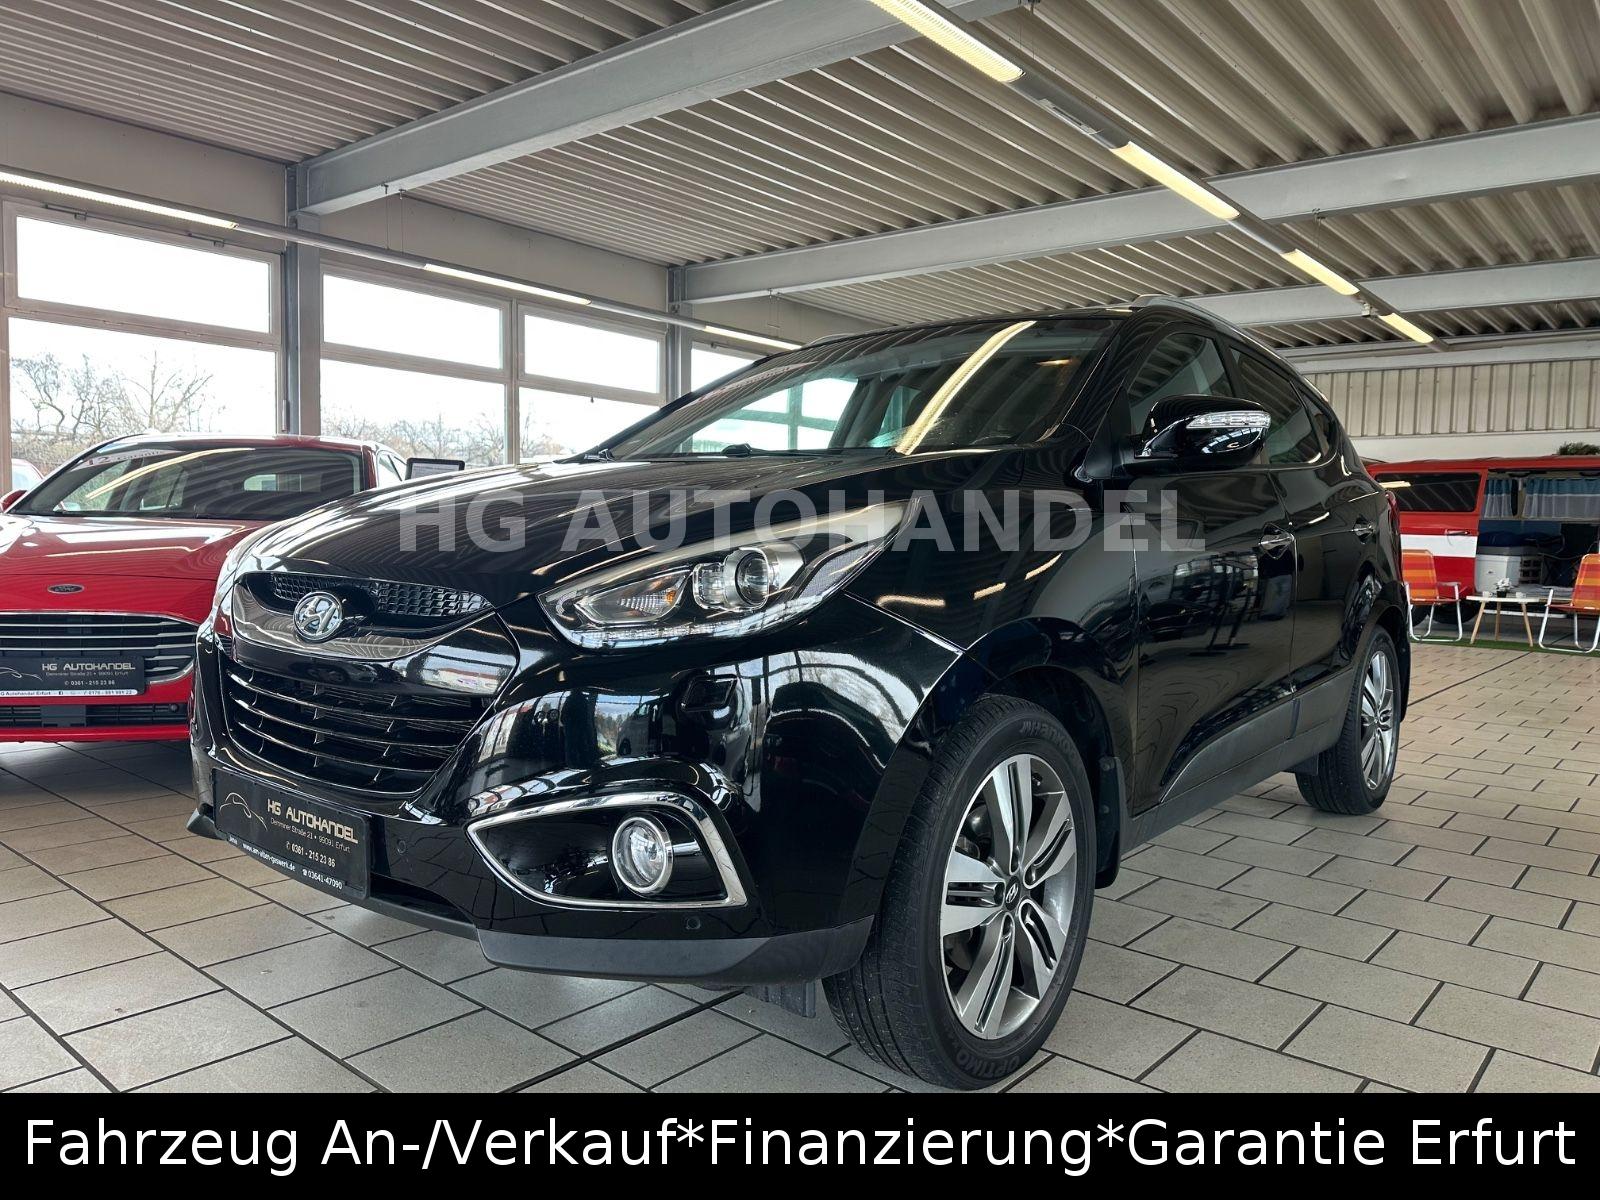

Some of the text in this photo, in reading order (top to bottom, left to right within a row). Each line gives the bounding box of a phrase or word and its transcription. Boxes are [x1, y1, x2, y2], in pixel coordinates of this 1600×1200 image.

[42, 662, 136, 671] HG AUTOHANDEL
[267, 798, 359, 844] HG AUTOHANDEL
[291, 825, 307, 837] Straße
[306, 831, 313, 839] 21
[319, 835, 334, 847] 99091
[335, 841, 351, 853] Erfurt
[291, 843, 304, 856] 0361
[308, 850, 319, 862] 215
[319, 854, 327, 864] 23
[327, 857, 336, 868] 86
[307, 870, 343, 890] 03641-47090
[956, 1048, 1020, 1078] OPTIMO
